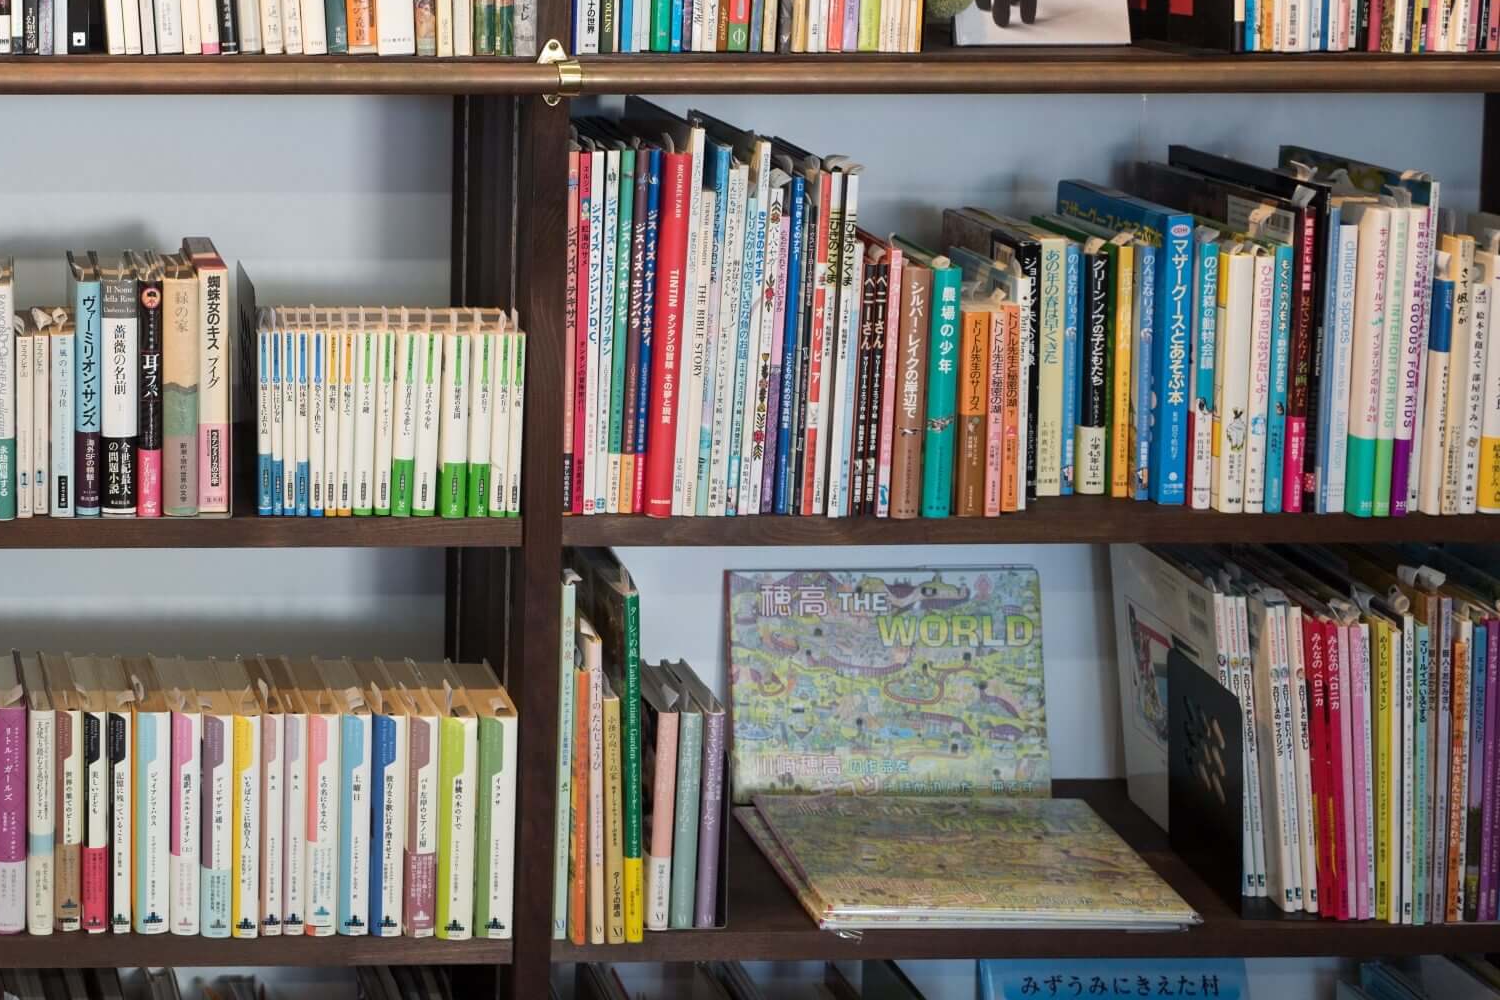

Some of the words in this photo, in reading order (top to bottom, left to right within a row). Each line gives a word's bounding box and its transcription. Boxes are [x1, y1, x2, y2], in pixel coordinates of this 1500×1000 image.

[207, 275, 221, 351] 蜘蛛女のキス
[667, 268, 679, 308] TINTIN
[1043, 249, 1061, 365] あの年の春は早くきた
[694, 304, 706, 336] BIBLE
[938, 286, 957, 375] 農場の少年
[1168, 239, 1189, 406] マザーグースとあそぶ本
[1410, 303, 1421, 354] GOODS
[82, 295, 97, 428] ヴァーミリオン・サンズ
[114, 323, 127, 396] 薔薇の名前
[691, 339, 704, 378] STORY
[969, 318, 983, 412] ドリトル先生のサーカス
[837, 591, 891, 612] THE
[876, 614, 1034, 649] WORLD
[1020, 974, 1221, 996] みずうみにきえた村
